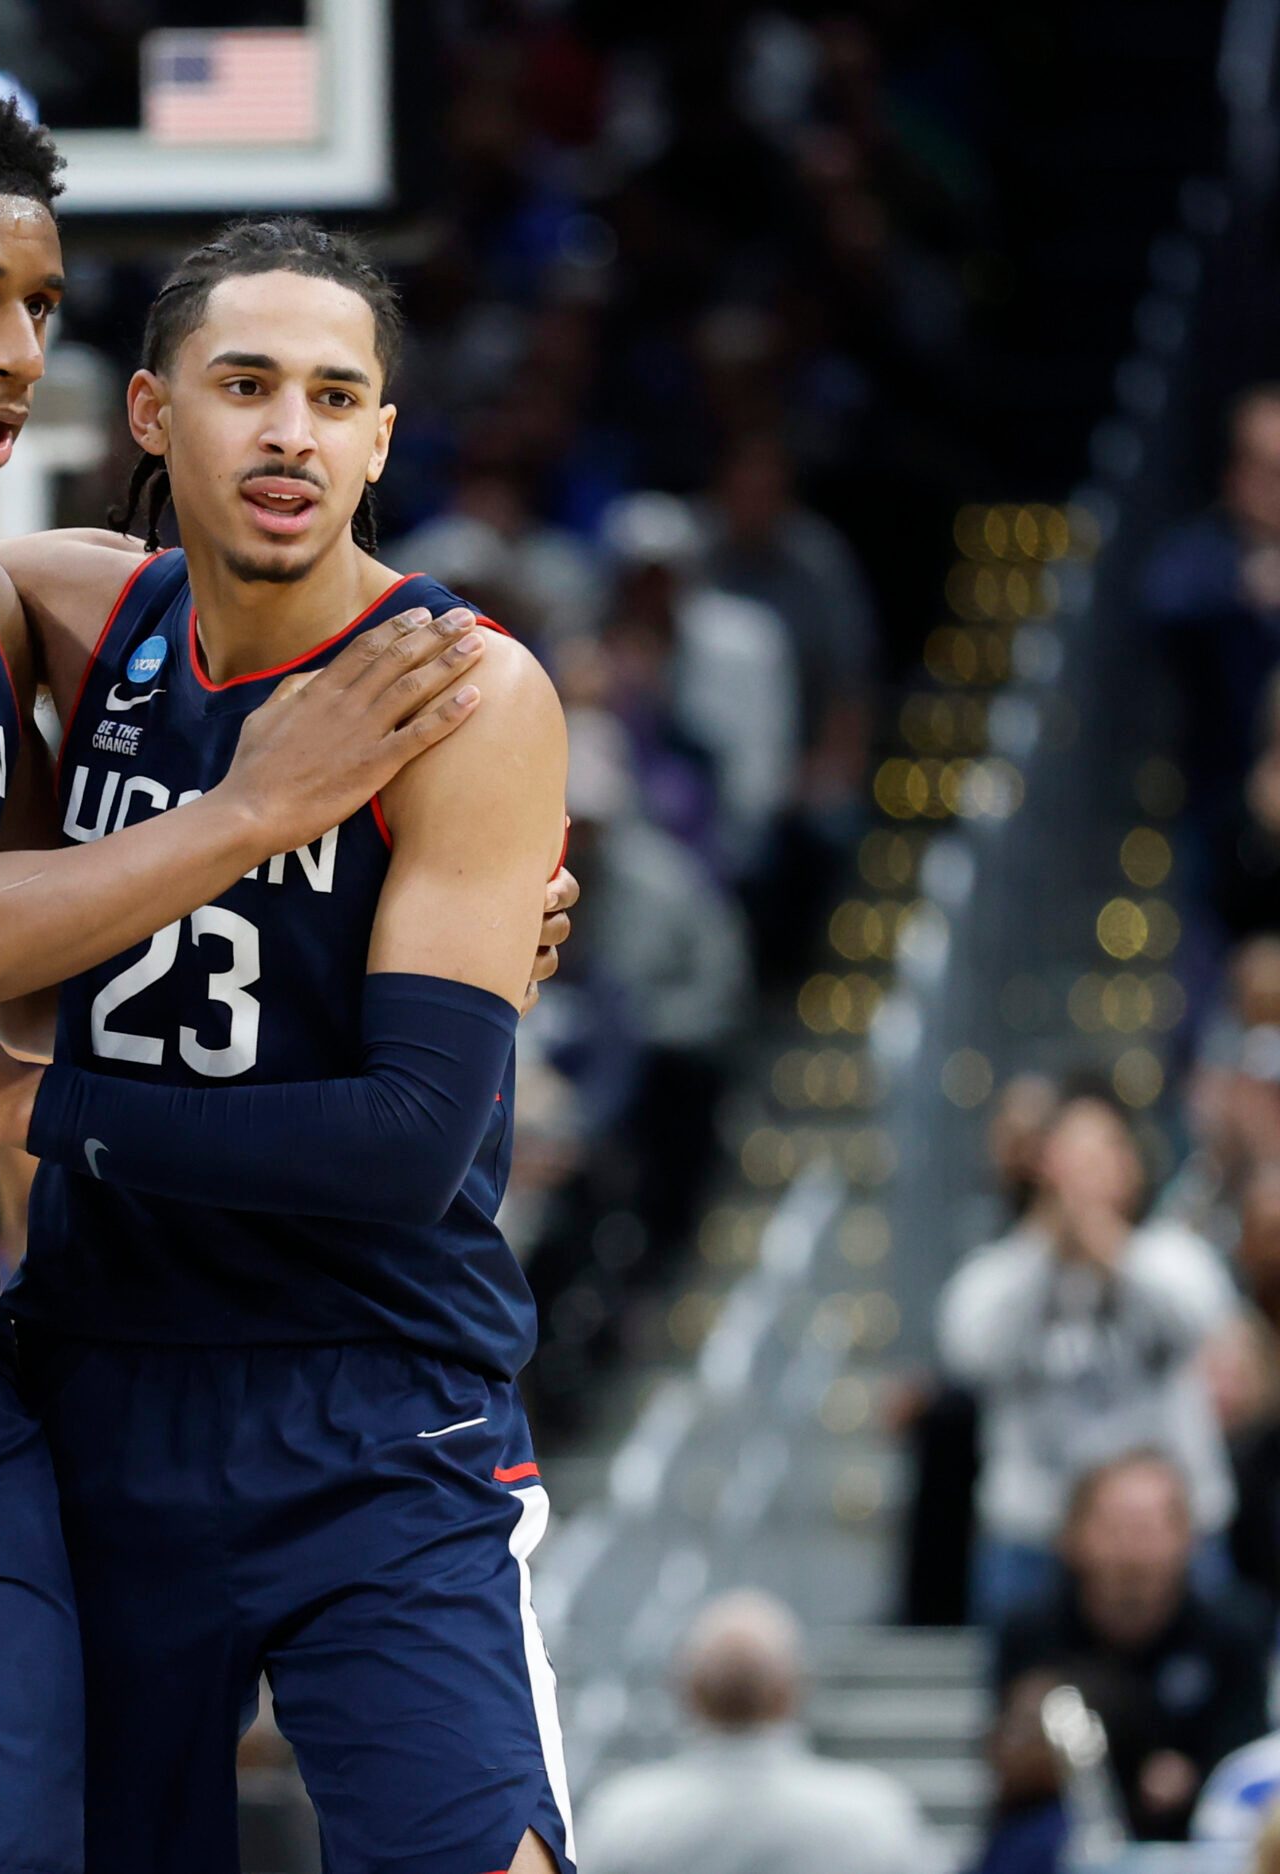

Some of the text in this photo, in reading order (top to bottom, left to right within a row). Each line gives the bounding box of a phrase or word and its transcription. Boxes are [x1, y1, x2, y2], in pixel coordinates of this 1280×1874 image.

[97, 720, 143, 741] BE THE
[92, 734, 139, 756] CHANGE
[91, 904, 261, 1078] 23
